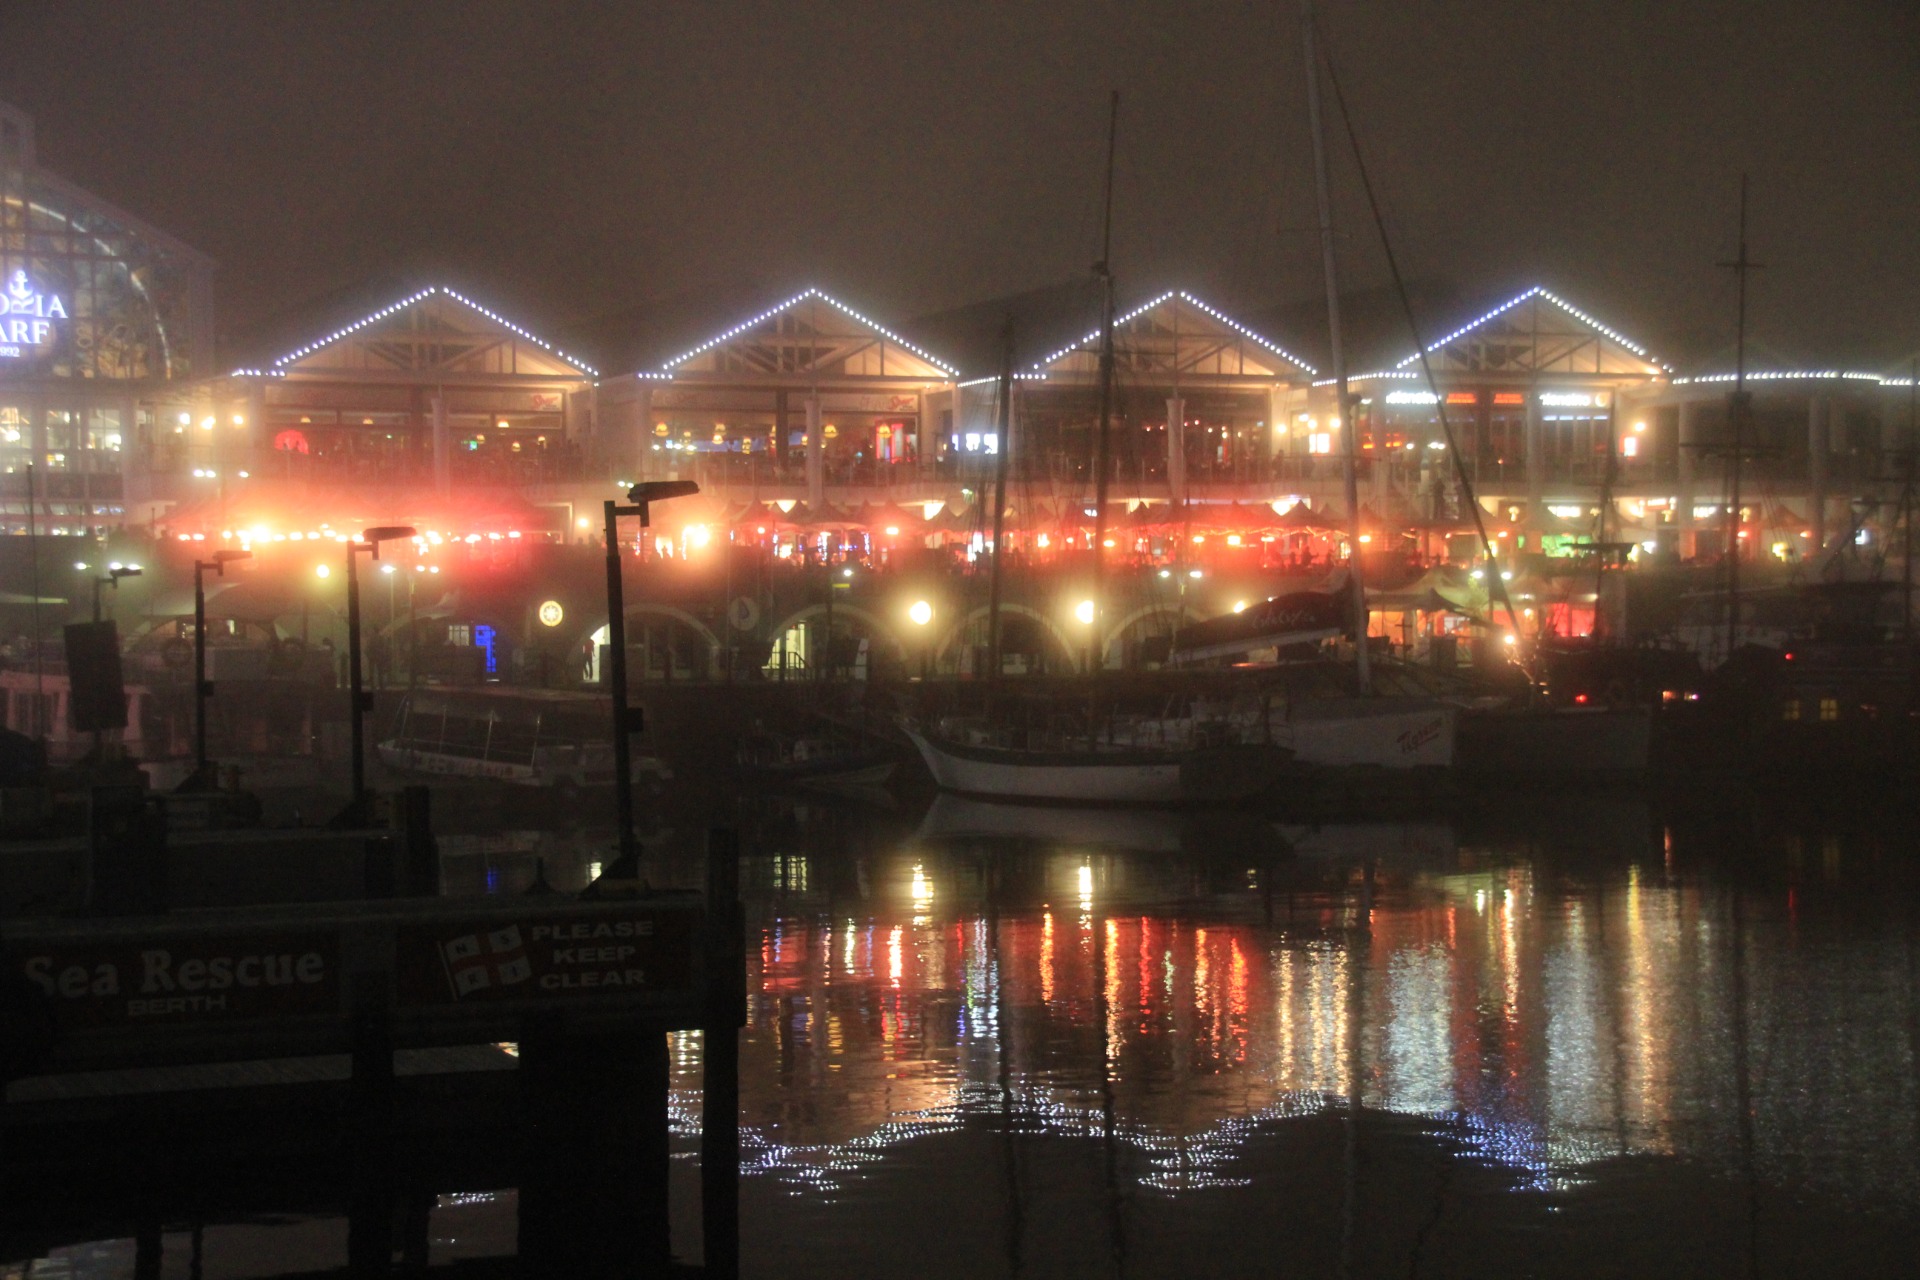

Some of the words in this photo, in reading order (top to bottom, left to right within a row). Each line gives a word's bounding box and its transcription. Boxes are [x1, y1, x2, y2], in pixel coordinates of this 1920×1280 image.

[532, 920, 654, 942] PLEASE
[552, 945, 636, 965] KEEP
[24, 956, 119, 998] Sea
[141, 949, 324, 992] Rescue
[539, 969, 646, 989] CLEAR
[128, 996, 226, 1017] BERTH
